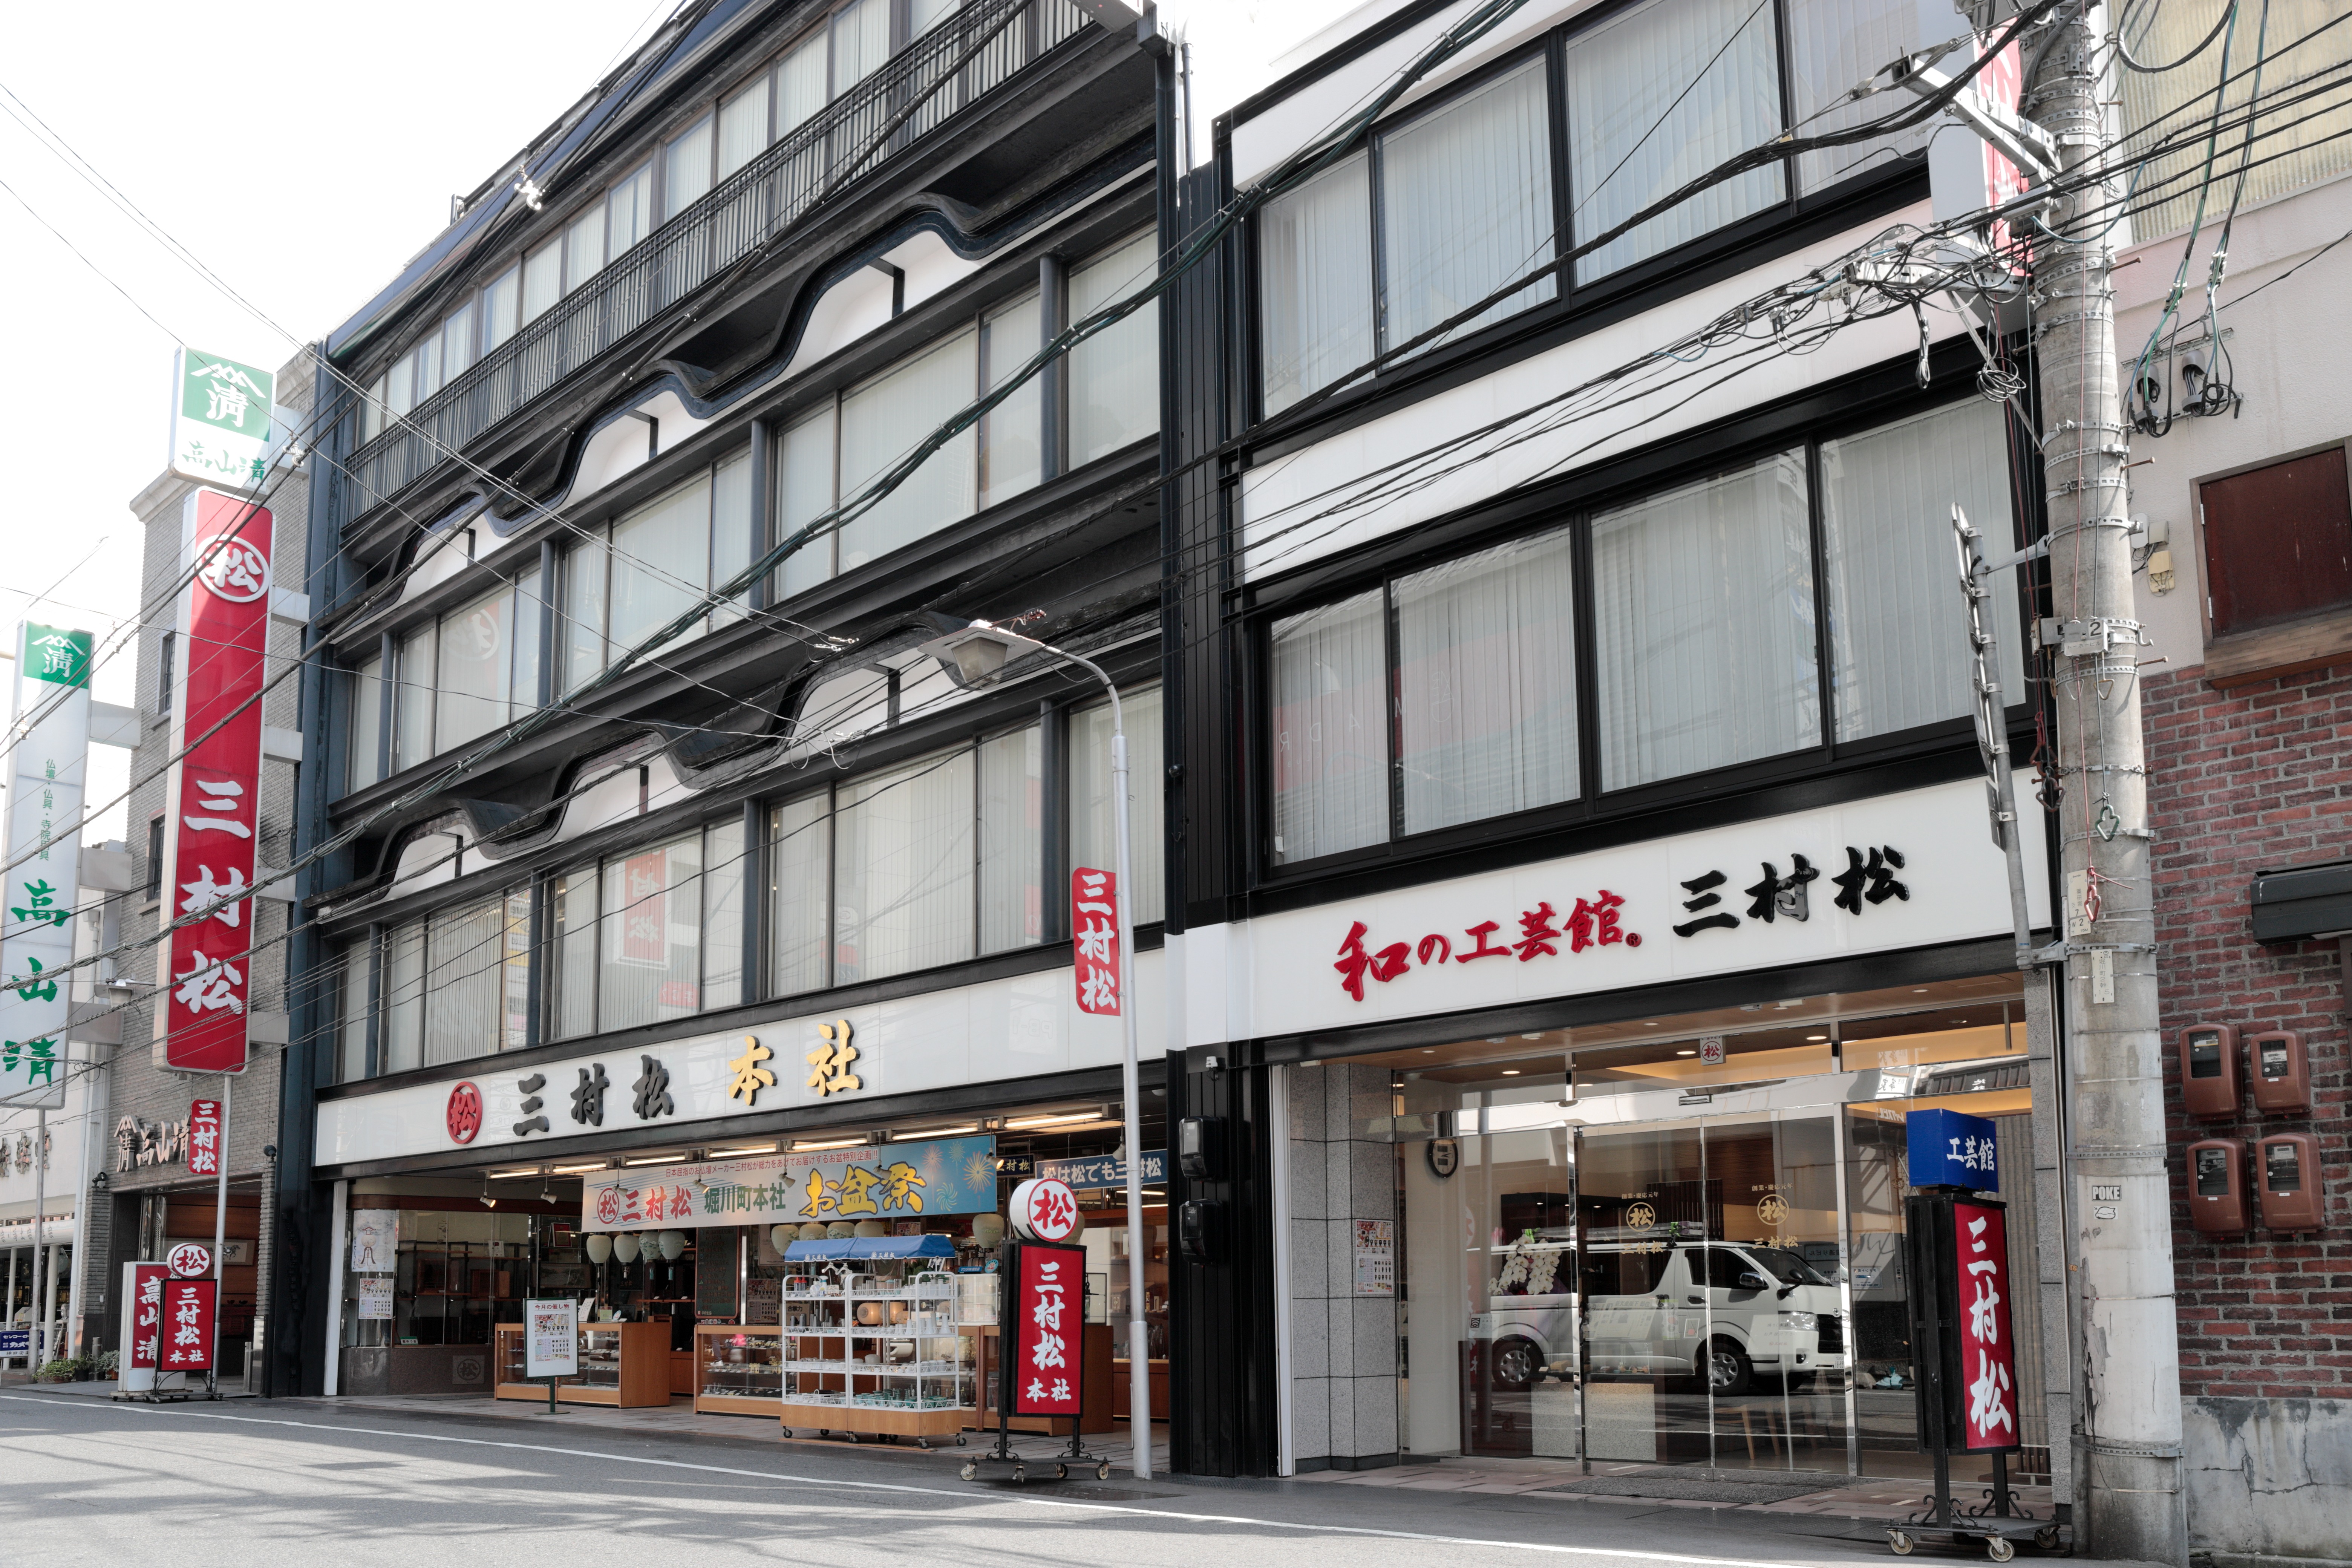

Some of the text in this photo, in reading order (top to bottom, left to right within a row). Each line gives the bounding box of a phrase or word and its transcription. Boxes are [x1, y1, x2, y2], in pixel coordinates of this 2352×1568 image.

[182, 440, 266, 483] 高山清
[203, 542, 263, 593] 松
[175, 779, 252, 1015] 三村松
[1672, 844, 1910, 938] 三村松
[1077, 872, 1116, 1011] 三村松
[1333, 890, 1626, 1002] 和の工芸館
[4, 878, 71, 1087] 高山清
[1704, 1044, 1720, 1058] 松
[513, 1019, 864, 1136] 三村松 本社
[450, 1092, 476, 1133] 松
[136, 1113, 191, 1167] 高山清
[192, 1102, 218, 1173] 三村松
[1946, 1135, 1995, 1171] 工芸館
[600, 1193, 617, 1219] 松
[621, 1182, 786, 1223] 三村松 堀川町本社
[798, 1161, 927, 1219] お盆祭
[1621, 1191, 1659, 1200] 創業・慶応元年
[1752, 1182, 1793, 1191] 創業・慶応元年
[2093, 1186, 2120, 1200] POKE
[1033, 1188, 1074, 1230] 松
[1629, 1207, 1653, 1227] 松
[1760, 1199, 1787, 1221] 松
[176, 1249, 208, 1272] 松
[1620, 1240, 1664, 1255] 三村松
[1753, 1234, 1799, 1250] 三村松
[174, 1287, 201, 1347] 三村松
[1032, 1261, 1065, 1371] 三村松
[1967, 1216, 2012, 1438] 三村松
[169, 1349, 204, 1363] 本社
[1026, 1377, 1072, 1403] 本社
